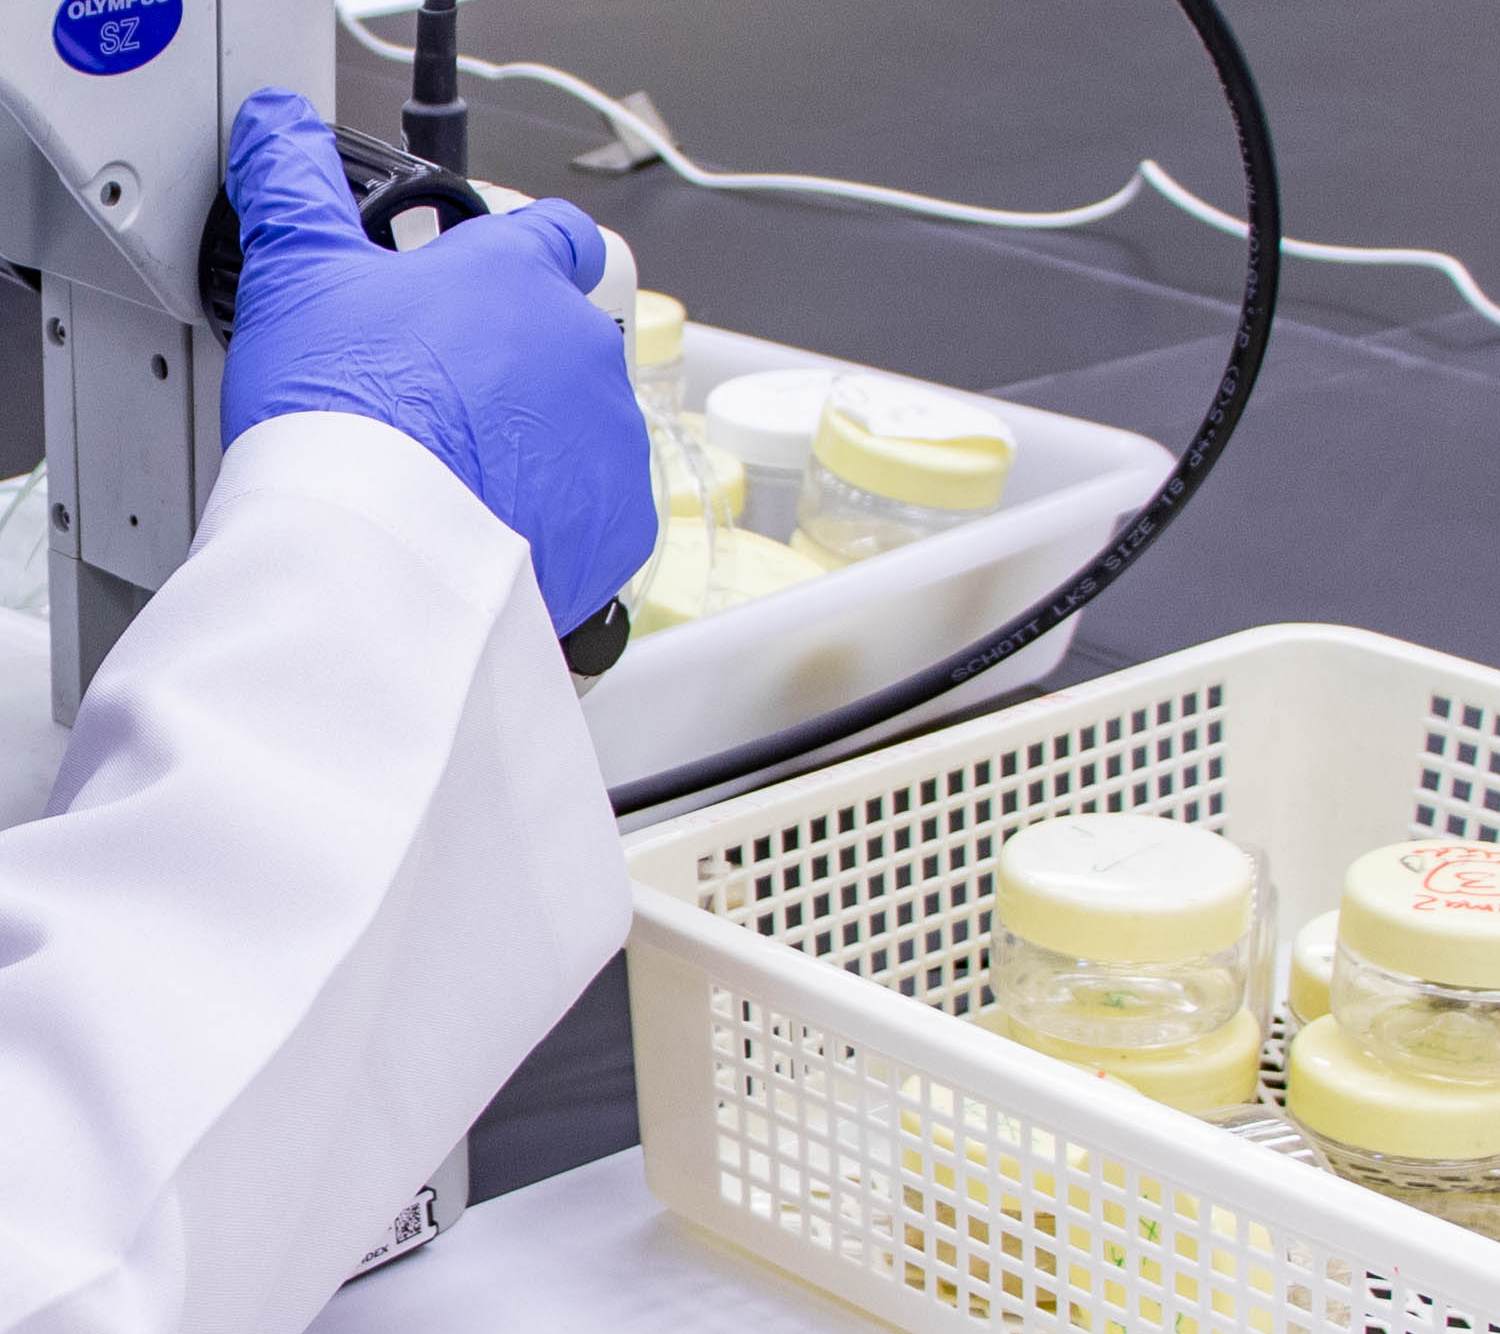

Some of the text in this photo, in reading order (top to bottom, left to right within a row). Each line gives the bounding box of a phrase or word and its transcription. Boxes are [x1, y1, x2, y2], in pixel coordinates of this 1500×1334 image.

[100, 16, 141, 55] SZ
[951, 618, 1041, 683] SCHOTT
[1053, 577, 1098, 617] LKS
[1104, 516, 1157, 570] SIZE
